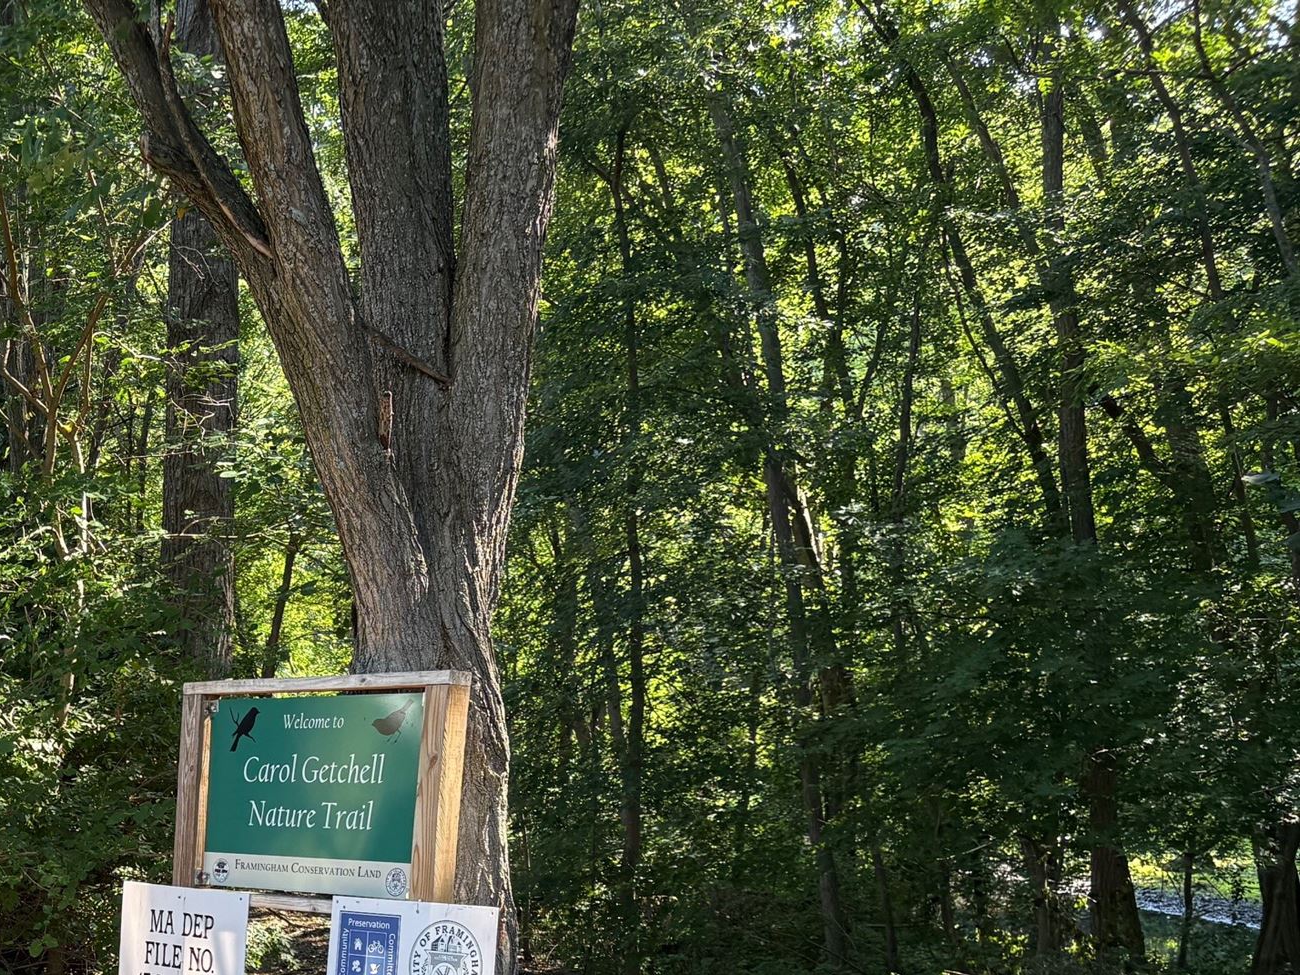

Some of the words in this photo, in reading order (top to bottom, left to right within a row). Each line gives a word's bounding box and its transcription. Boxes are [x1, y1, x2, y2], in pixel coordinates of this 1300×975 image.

[283, 712, 330, 729] Welcome
[332, 714, 344, 729] to
[243, 754, 298, 783] Carol
[302, 754, 386, 784] Getchell
[248, 800, 316, 828] Nature
[321, 800, 374, 830] Trail
[234, 858, 289, 873] FRAMINGHAM
[290, 862, 355, 877] CONSERVATION
[357, 866, 382, 879] LAND
[150, 908, 175, 935] MA
[182, 912, 215, 940] DEP
[348, 918, 390, 930] Preservation
[420, 932, 431, 948] OF
[144, 940, 182, 970] FILE
[188, 946, 214, 974] NO.
